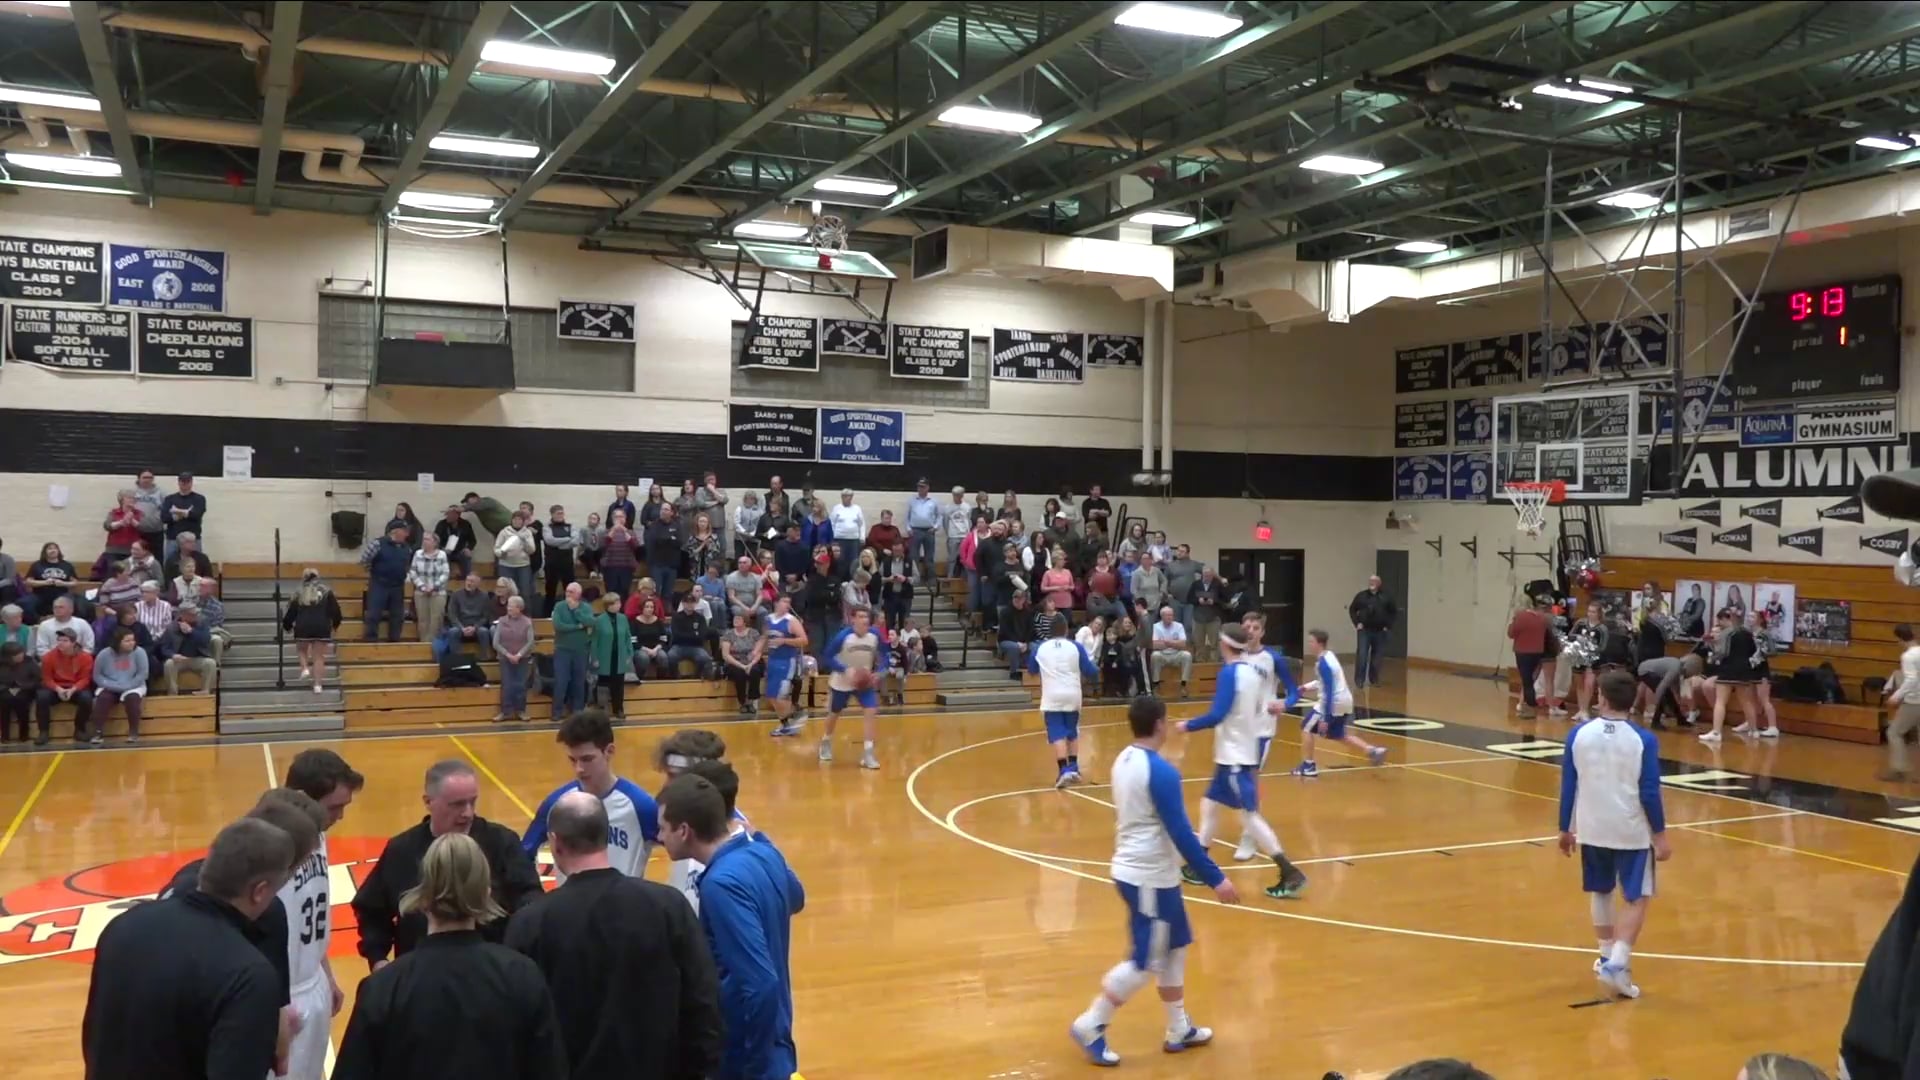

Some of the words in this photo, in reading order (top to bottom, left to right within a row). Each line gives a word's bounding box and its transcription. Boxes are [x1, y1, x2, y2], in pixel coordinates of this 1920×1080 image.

[32, 243, 96, 258] CHAMPIONS
[22, 257, 98, 273] BASKETBALL
[114, 253, 140, 270] GOOD
[143, 250, 219, 276] SPORTSMANSHIP
[152, 259, 185, 270] AWARD
[11, 272, 60, 284] CLASS
[65, 275, 76, 285] C
[117, 277, 144, 288] EAST
[22, 286, 63, 297] 2004
[15, 309, 51, 320] STATE
[55, 311, 127, 325] RUNNERS-UP
[768, 317, 812, 329] CHAMPIONS
[14, 321, 51, 333] EASTERN
[55, 323, 80, 334] MAINE
[85, 325, 128, 337] CHAMPIONS
[147, 318, 182, 330] STATE
[187, 320, 243, 332] CHAMPIONS
[763, 327, 807, 339] CHAMPIONS
[898, 327, 921, 337] STATE
[923, 328, 964, 340] CHAMPIONS
[51, 335, 91, 346] 2004
[146, 333, 244, 347] CHEERLEADING
[920, 338, 959, 349] CHAMPIONS
[33, 345, 110, 357] SOFTBALL
[166, 348, 211, 358] CLASS
[215, 350, 225, 359] C
[784, 349, 804, 357] GOLF
[995, 342, 1050, 365] SPORTSMANSHIP
[41, 356, 89, 367] CLASS
[92, 358, 103, 367] C
[1037, 369, 1077, 380] BASKETBALL
[734, 422, 788, 433] SPORTSMANSHIP
[848, 421, 876, 430] AWARD
[1800, 420, 1892, 438] GYMNASIUM
[823, 436, 844, 445] EAST
[881, 438, 901, 447] 2014
[763, 445, 804, 454] BASKETBALL
[1682, 445, 1911, 489] ALUMNI
[1720, 534, 1747, 542] COWAN
[1788, 536, 1815, 545] SMITH
[300, 892, 327, 945] 32
